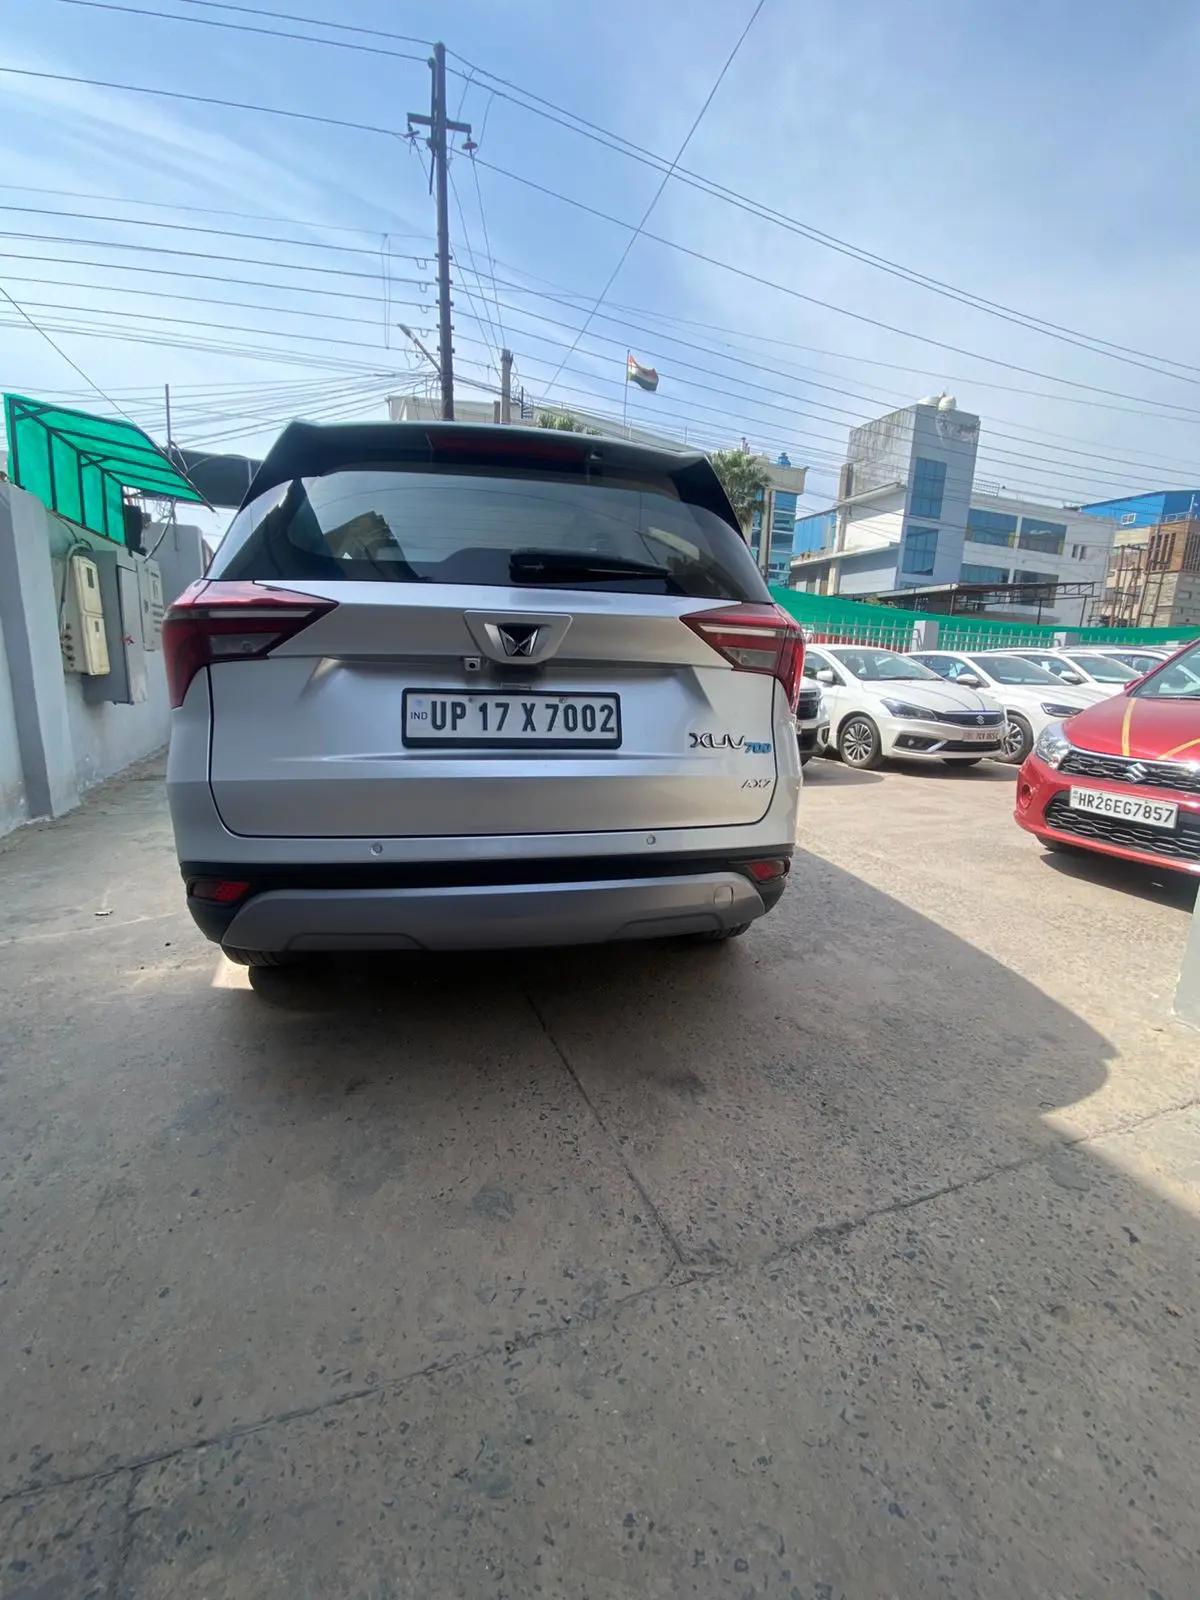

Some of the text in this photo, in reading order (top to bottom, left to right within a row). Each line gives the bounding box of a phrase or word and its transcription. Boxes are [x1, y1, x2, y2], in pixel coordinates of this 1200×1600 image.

[411, 711, 428, 720] IND
[431, 700, 615, 733] UP 17 X 7002
[1078, 792, 1175, 823] HR26EG7857
